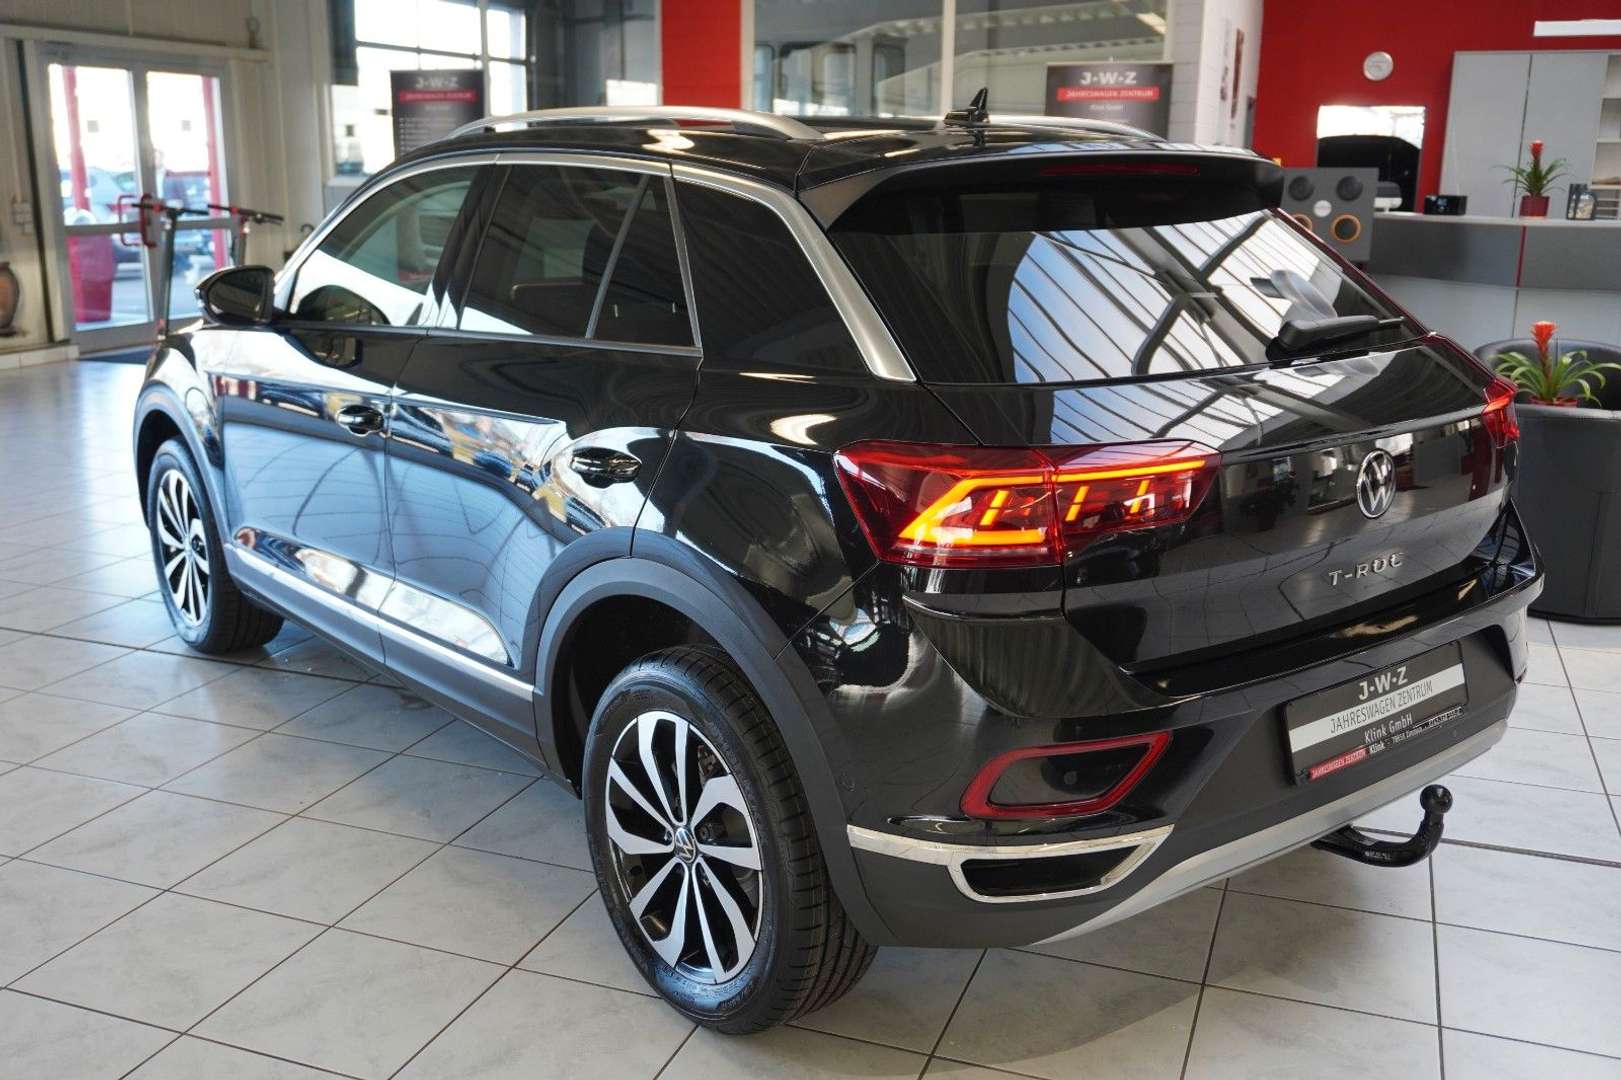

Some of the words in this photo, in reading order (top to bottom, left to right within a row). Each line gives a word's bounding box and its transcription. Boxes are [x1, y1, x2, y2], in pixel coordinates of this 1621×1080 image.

[1329, 553, 1404, 586] T-ROC
[1330, 699, 1396, 733] JAHRESWAGEN
[1399, 680, 1433, 707] ZENTRUM
[1364, 723, 1387, 745] Klink
[1389, 712, 1413, 733] GmbH
